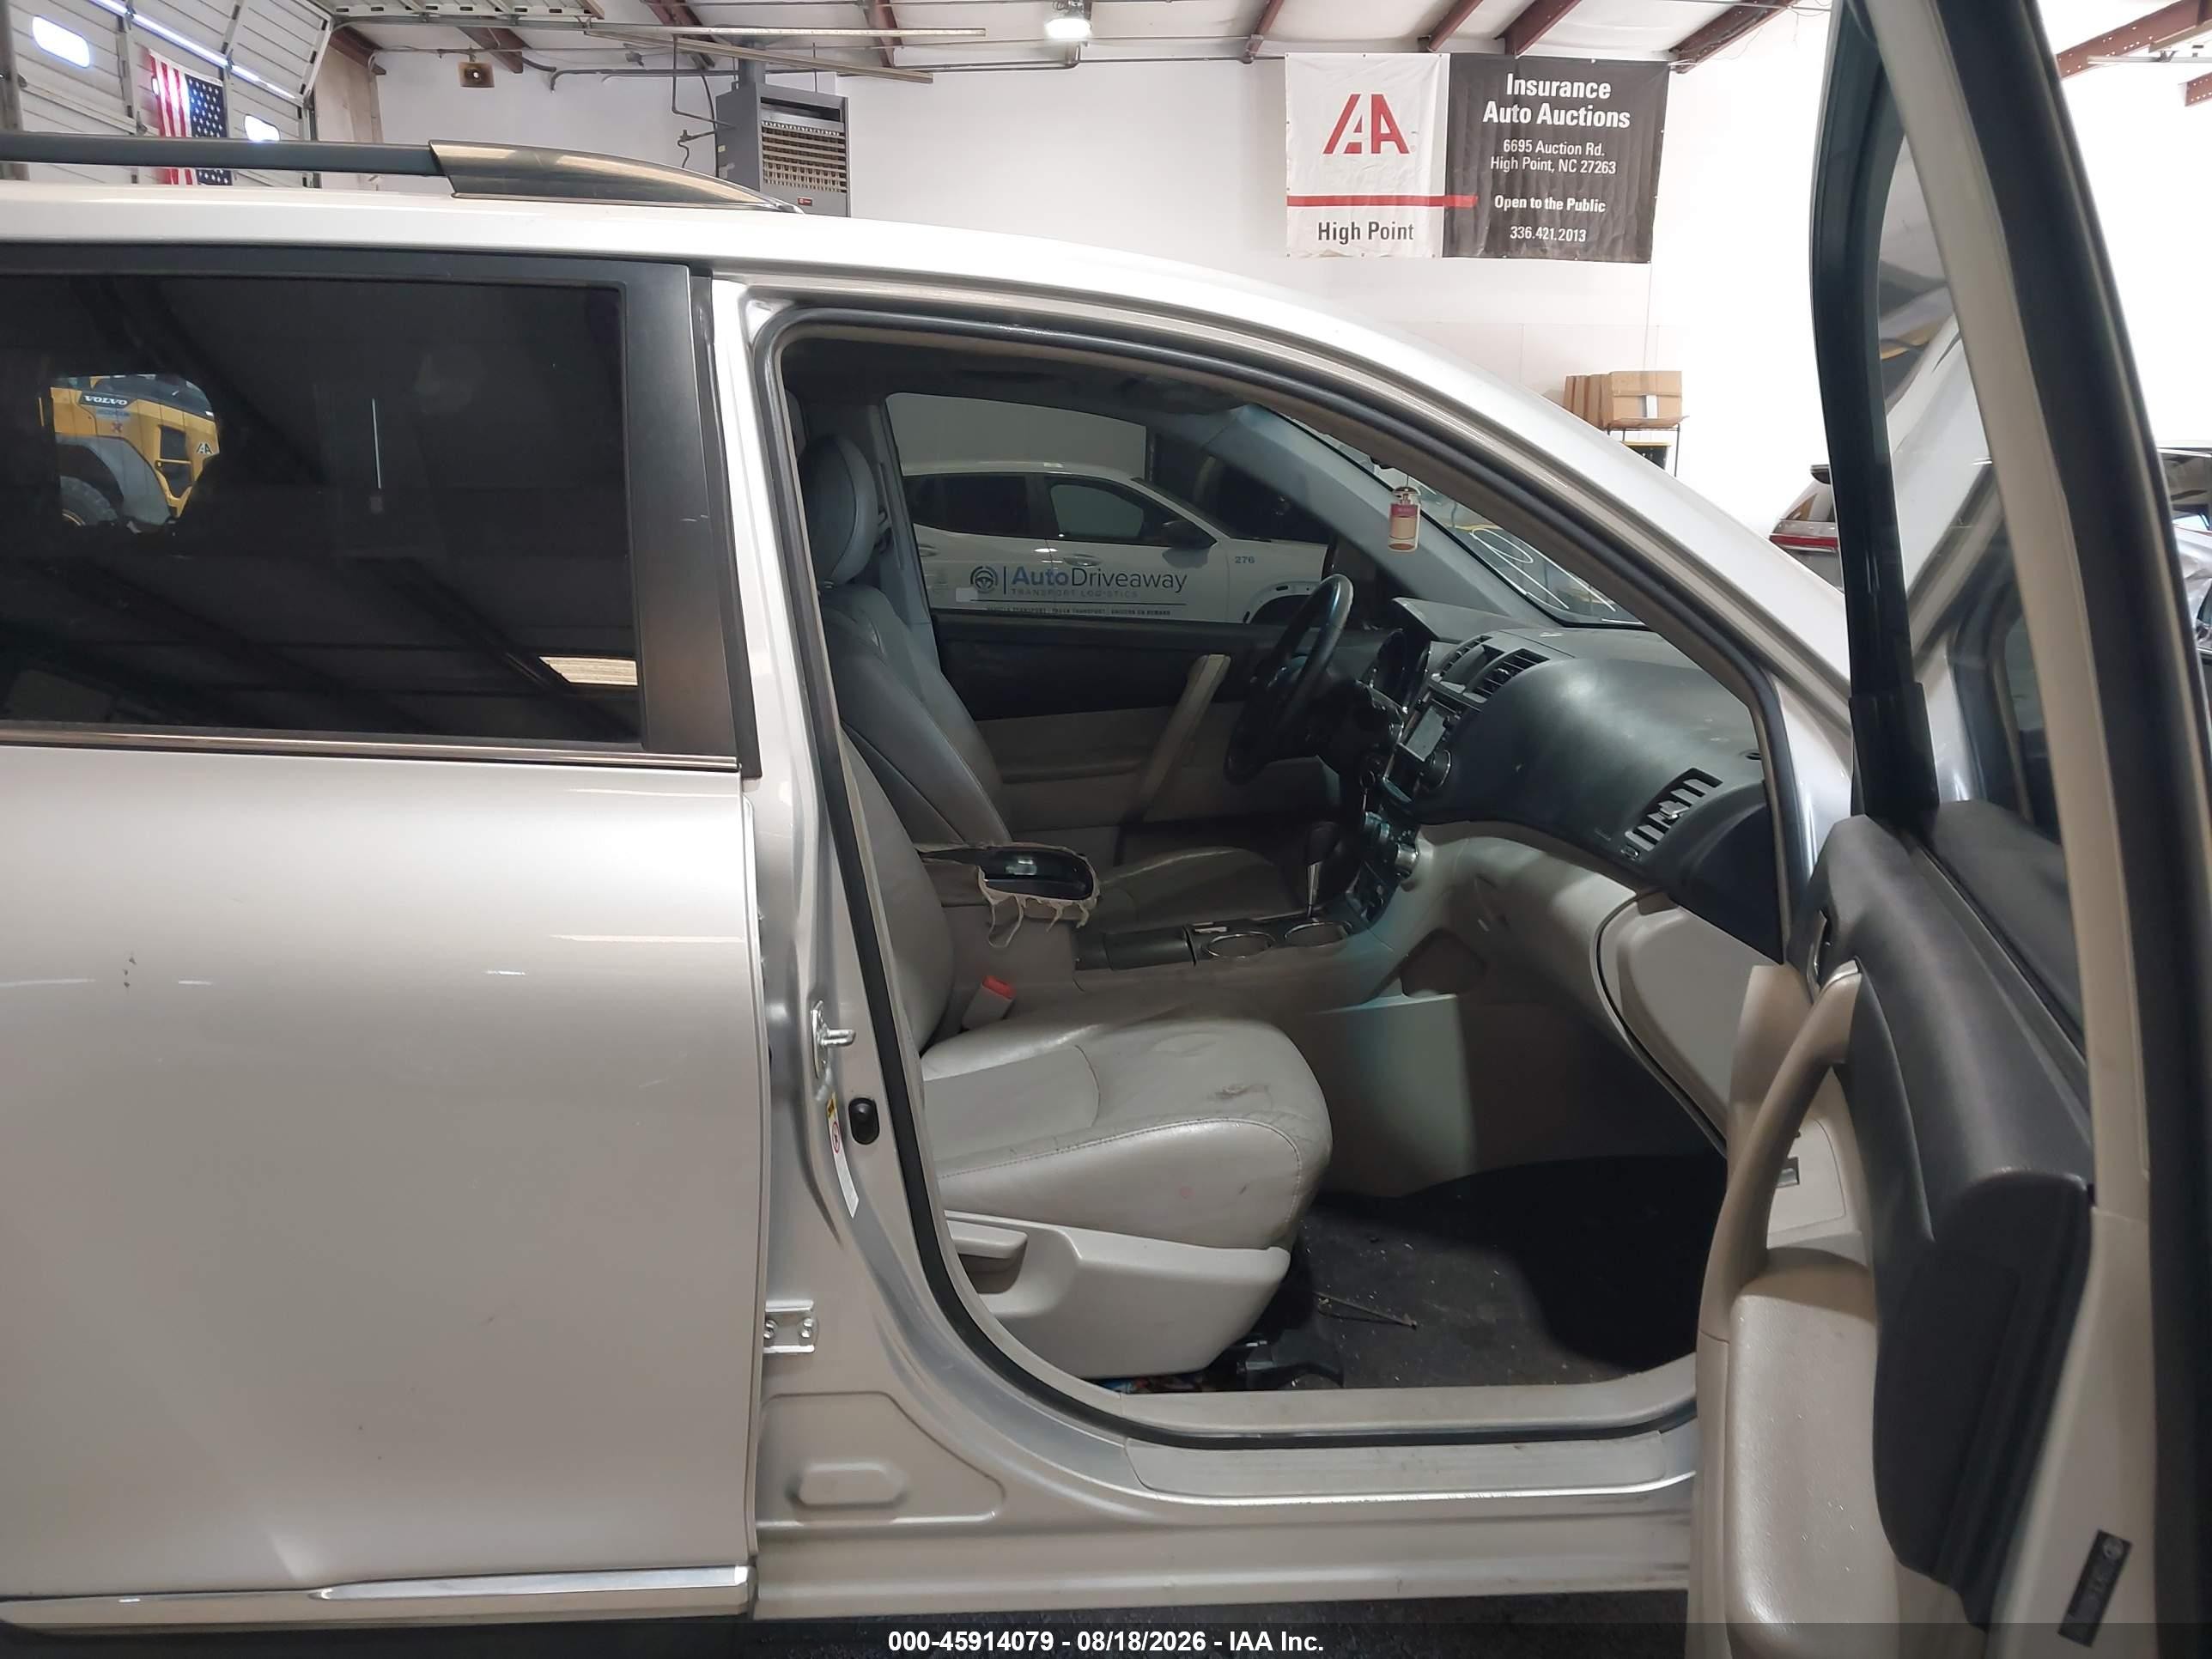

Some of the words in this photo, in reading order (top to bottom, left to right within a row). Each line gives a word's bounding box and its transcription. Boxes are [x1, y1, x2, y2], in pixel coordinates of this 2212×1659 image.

[1506, 73, 1612, 100] Insurance
[1482, 100, 1532, 124] Auto
[1536, 102, 1631, 129] Auctions
[1504, 139, 1533, 153] 6695
[1535, 140, 1582, 155] Auction
[1585, 142, 1605, 156] Rd.
[1491, 156, 1518, 172] High
[1522, 157, 1554, 173] Point,
[1559, 159, 1577, 173] NC
[1580, 161, 1616, 173] 27263
[1494, 195, 1527, 211] Open
[1530, 197, 1542, 209] to
[1545, 197, 1564, 210] the
[1566, 198, 1606, 212] Public
[1318, 221, 1361, 245] High
[1368, 221, 1414, 240] Point
[1510, 226, 1587, 242] 336.421.2013
[84, 395, 128, 406] VOLVO
